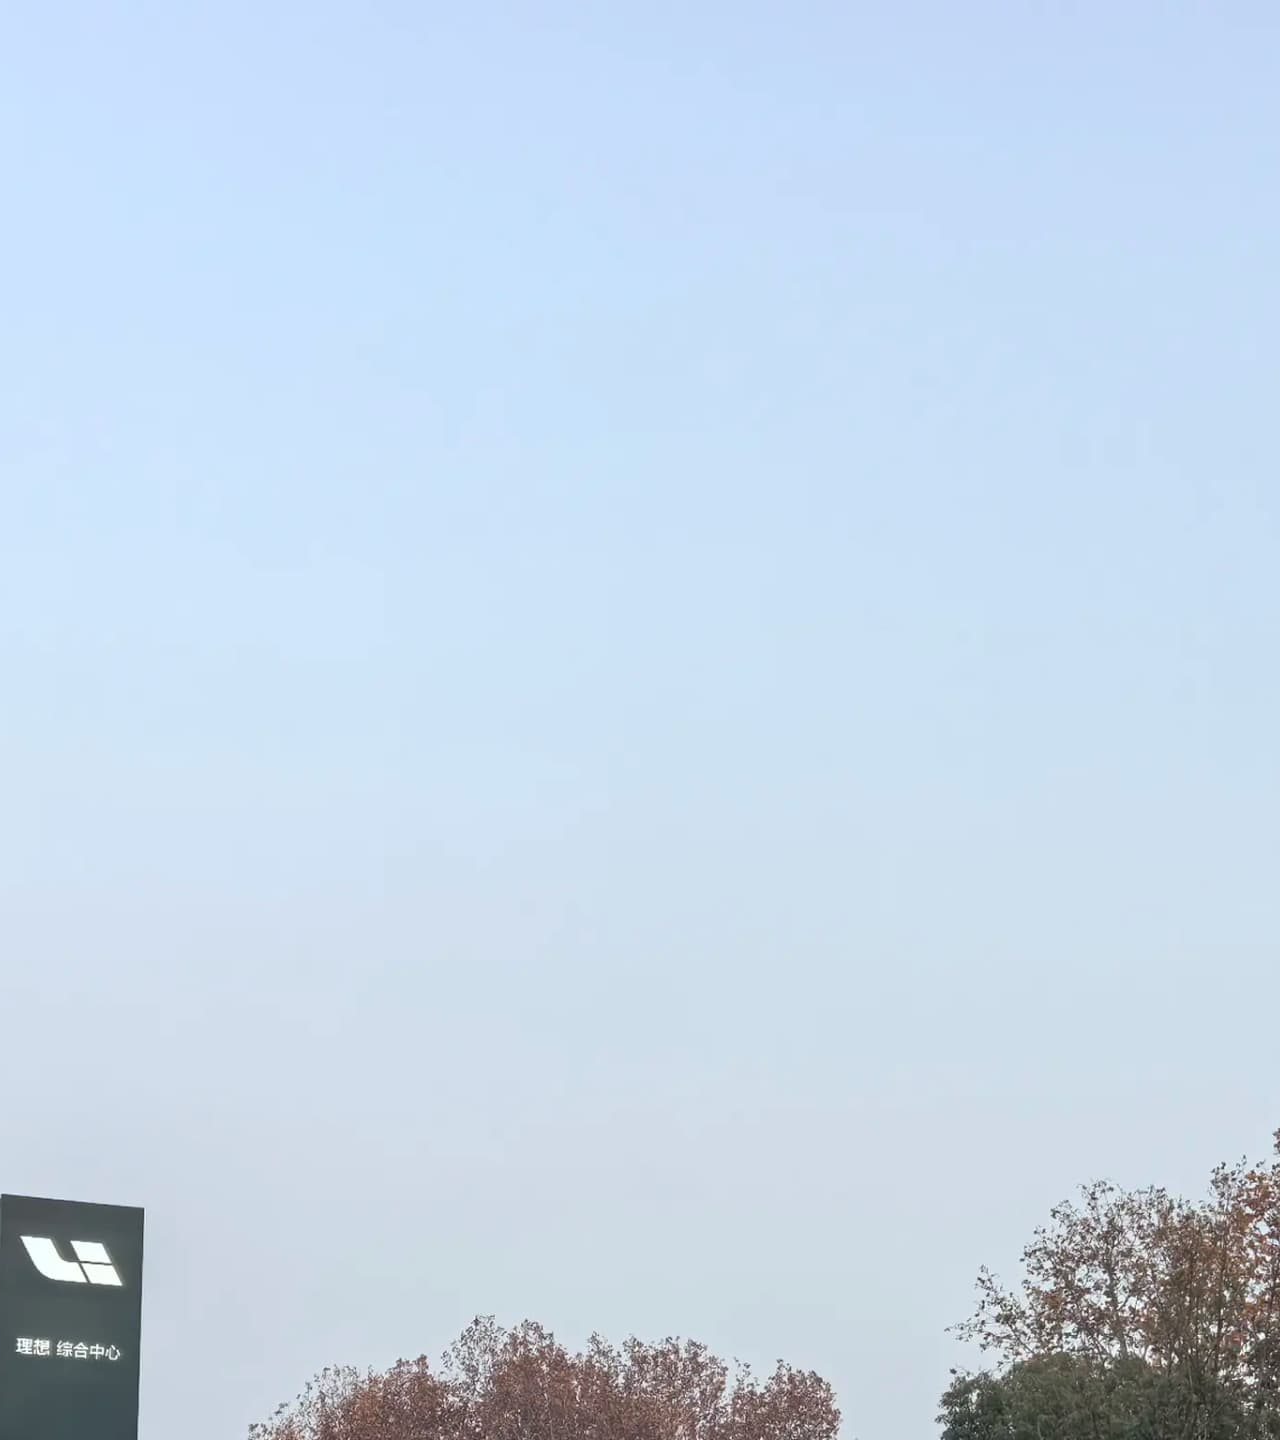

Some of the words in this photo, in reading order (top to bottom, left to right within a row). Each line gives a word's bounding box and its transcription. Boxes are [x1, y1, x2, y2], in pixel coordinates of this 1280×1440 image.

[15, 1337, 51, 1356] 理想
[56, 1340, 121, 1361] 综合中心
